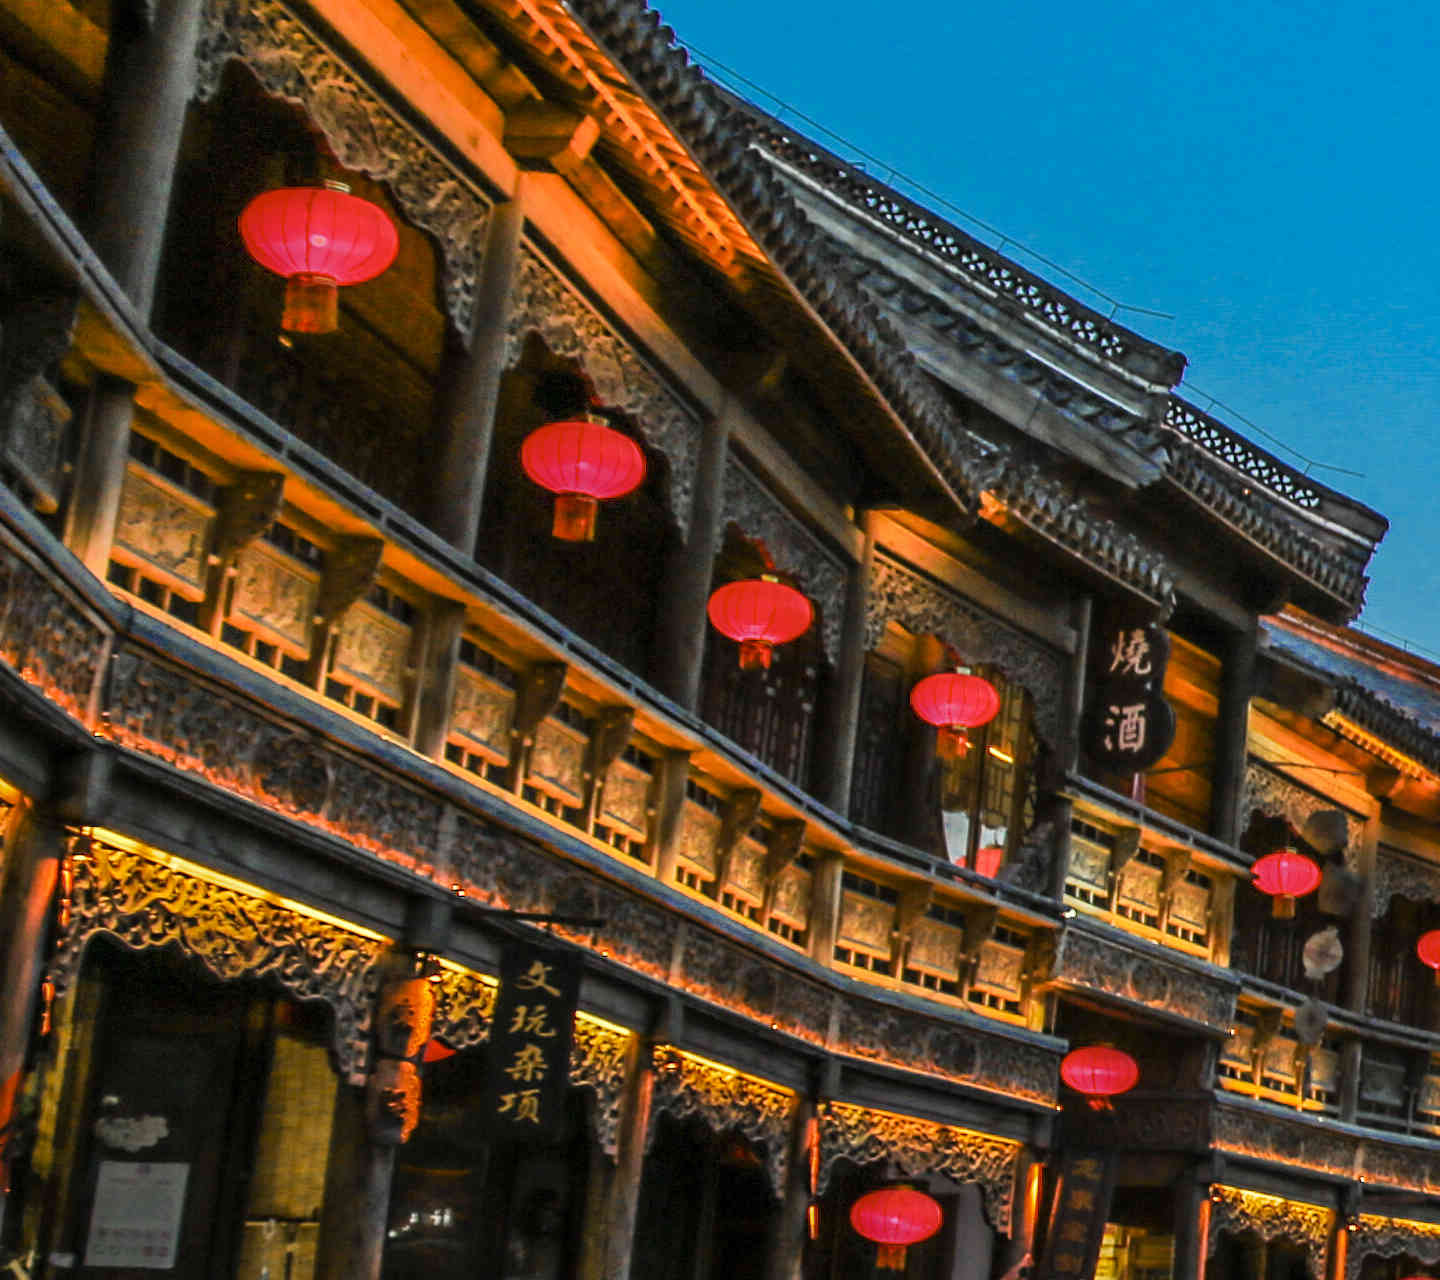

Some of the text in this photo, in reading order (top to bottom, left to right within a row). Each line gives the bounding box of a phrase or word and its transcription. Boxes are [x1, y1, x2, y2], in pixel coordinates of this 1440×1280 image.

[1104, 629, 1151, 752] 燒酒
[496, 959, 561, 1125] 文玩杂项
